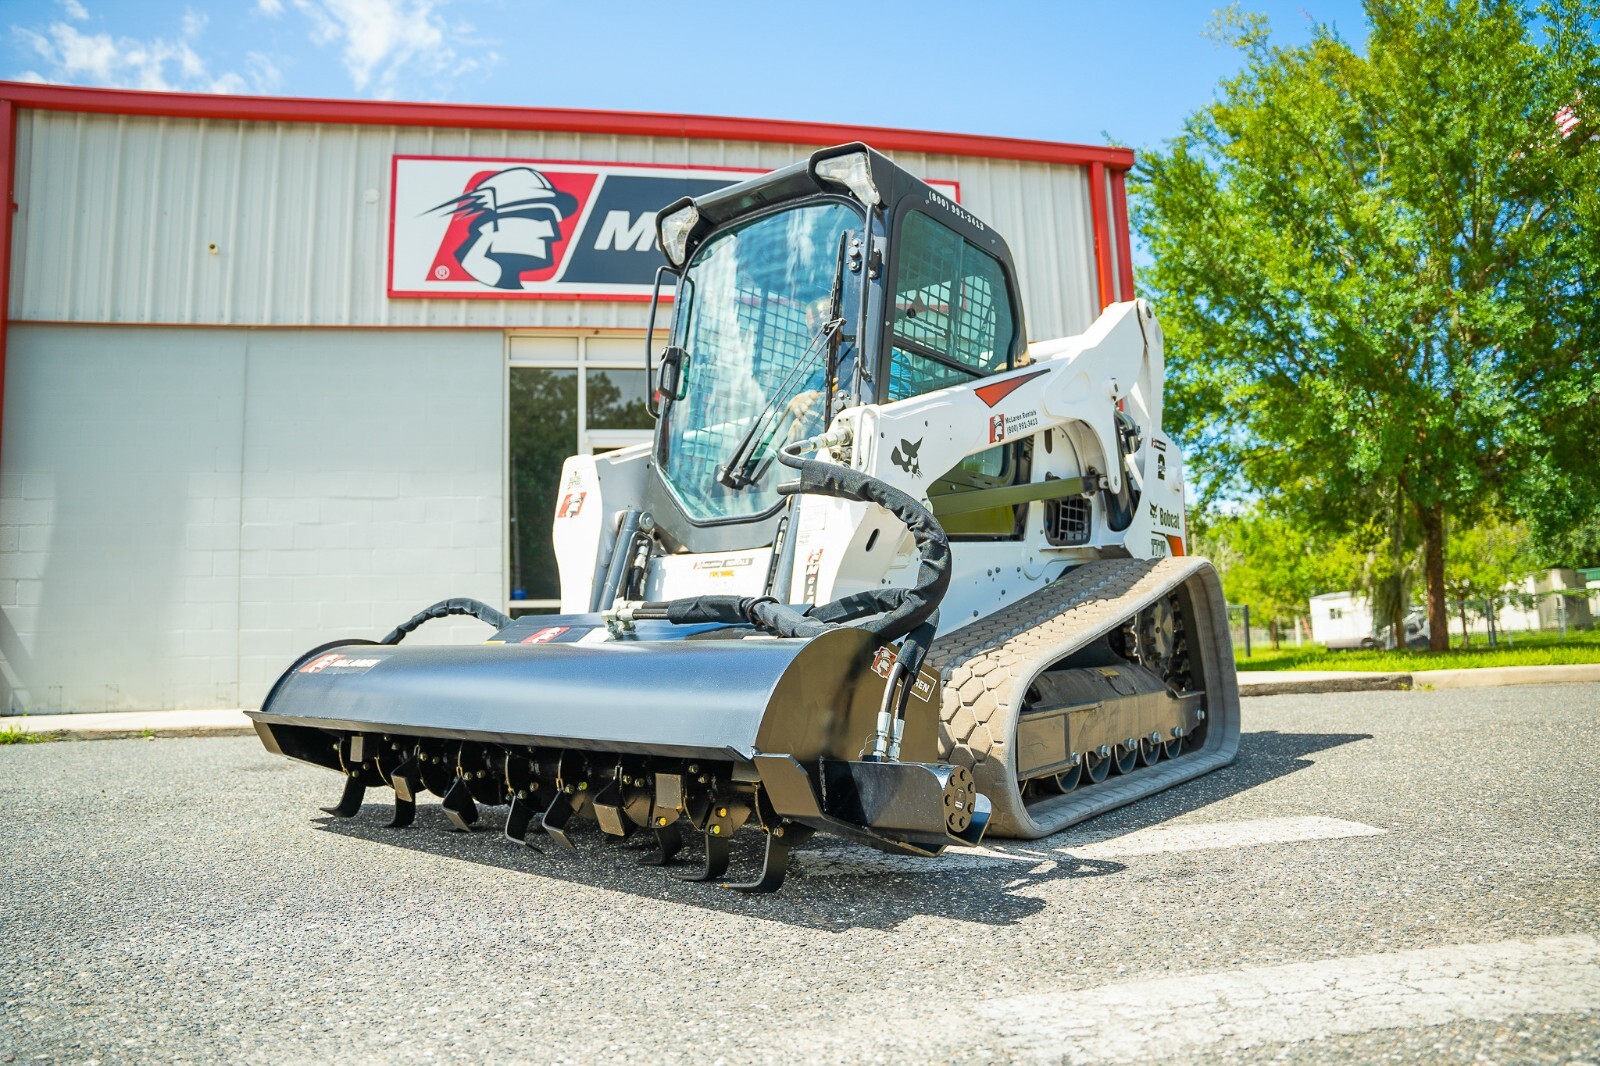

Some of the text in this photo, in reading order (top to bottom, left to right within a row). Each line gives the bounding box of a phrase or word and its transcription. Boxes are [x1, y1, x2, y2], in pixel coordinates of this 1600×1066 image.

[928, 190, 985, 231] (800) 991-3413
[593, 209, 662, 252] M
[1004, 409, 1037, 424] McLaren Rentals
[1159, 507, 1180, 530] Bobcat
[913, 678, 930, 694] REN
